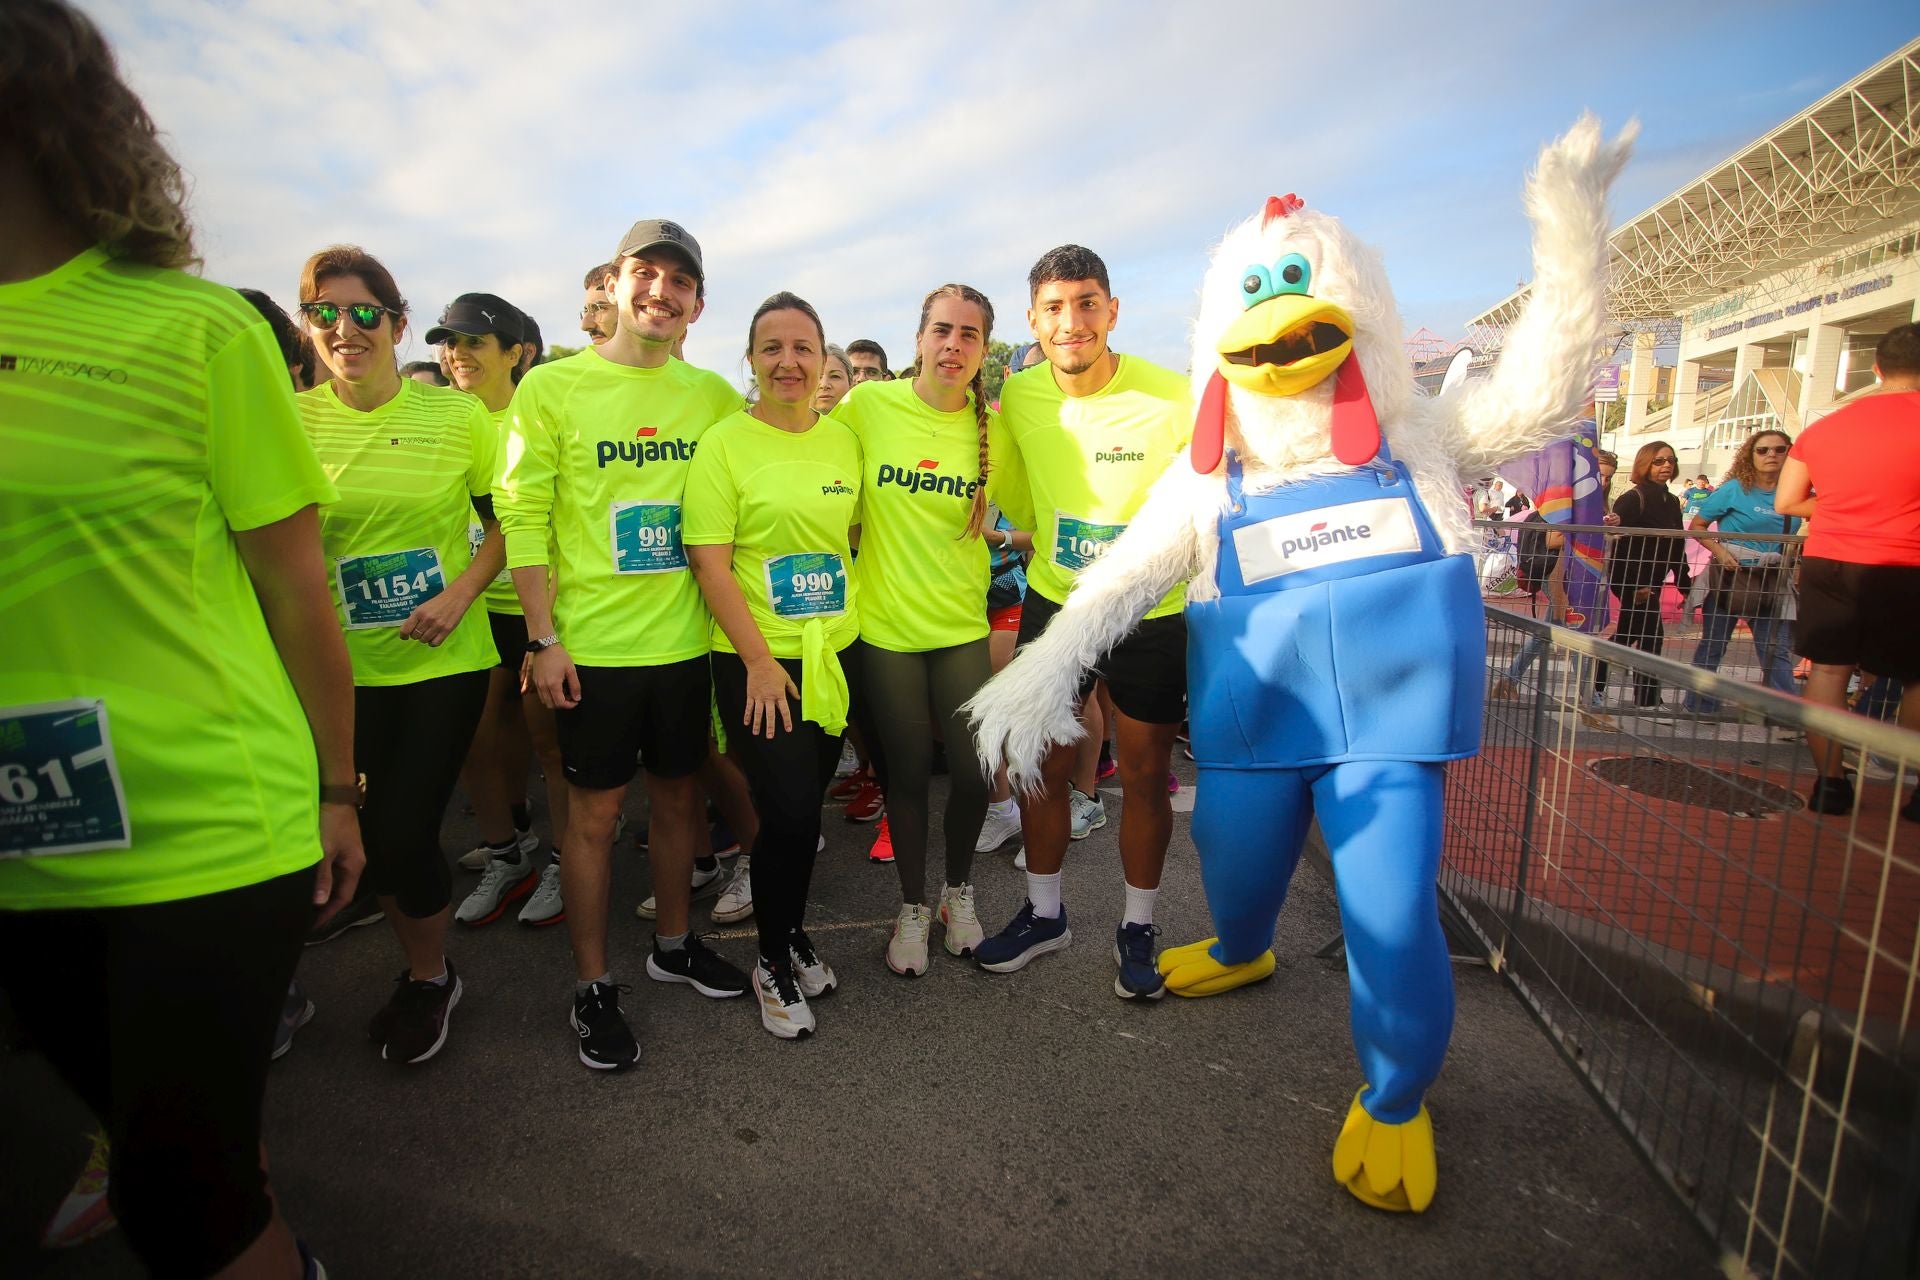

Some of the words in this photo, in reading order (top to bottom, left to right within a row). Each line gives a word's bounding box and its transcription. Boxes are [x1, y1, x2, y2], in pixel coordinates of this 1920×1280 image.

[19, 356, 128, 385] TAKASAGO
[1096, 450, 1144, 463] pujante
[877, 464, 977, 500] pujante
[1282, 524, 1371, 559] pujante
[358, 571, 429, 600] 1154
[791, 572, 833, 593] 990
